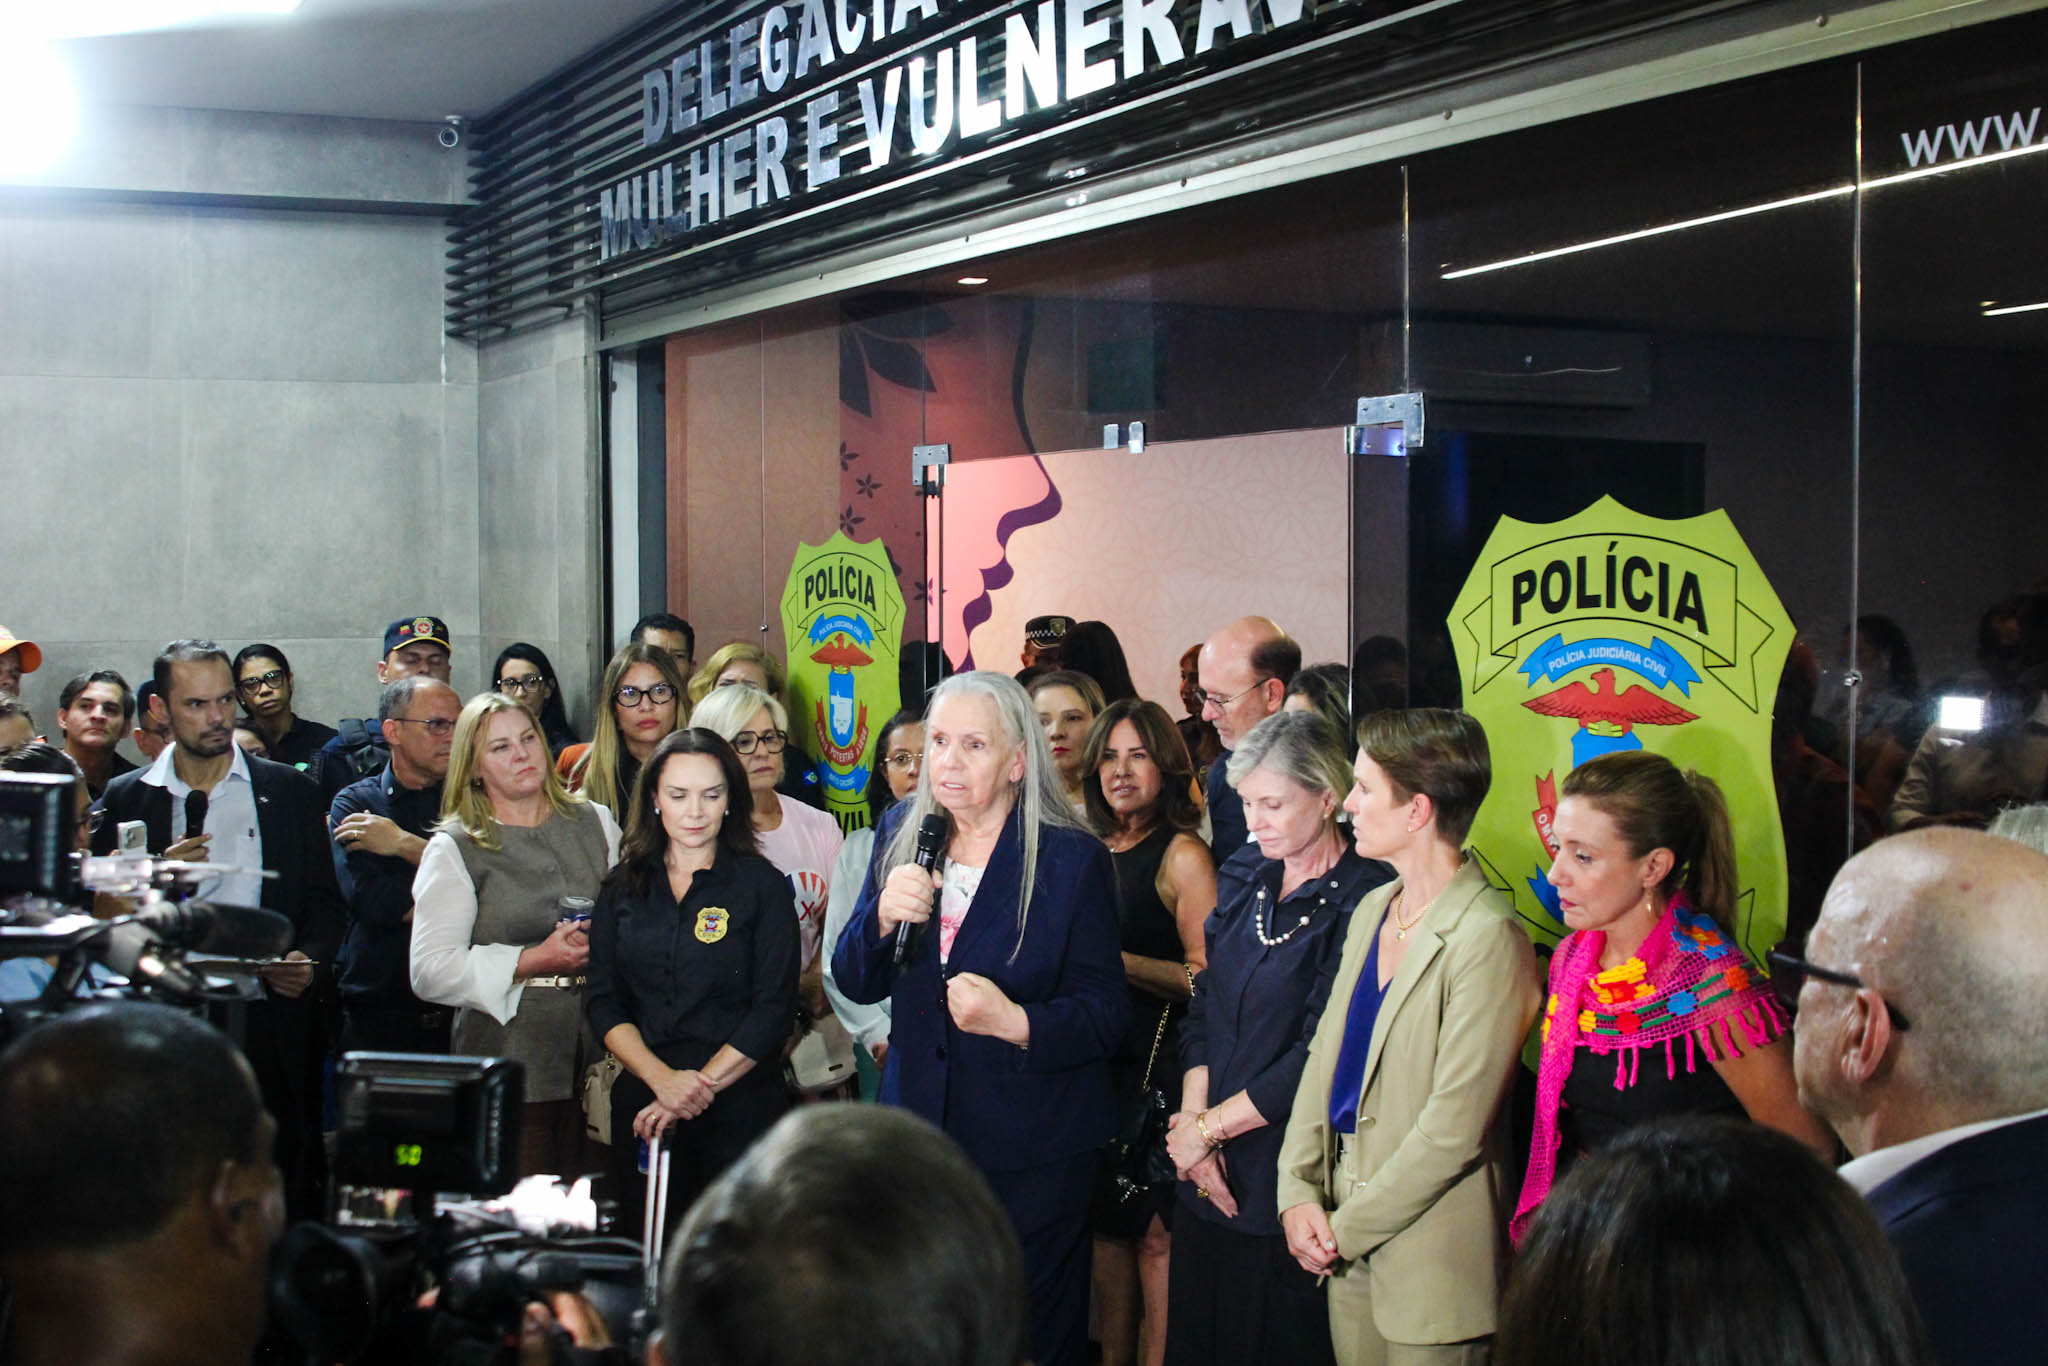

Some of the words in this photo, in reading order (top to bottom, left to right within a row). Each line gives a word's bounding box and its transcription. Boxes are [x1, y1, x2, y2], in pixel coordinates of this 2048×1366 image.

[600, 116, 791, 262] MULHER
[806, 90, 841, 194] E
[856, 0, 1303, 168] VULNER
[804, 556, 877, 612] POLÍCIA
[1512, 541, 1709, 635] POLÍCIA
[1643, 656, 1668, 679] CIVIL
